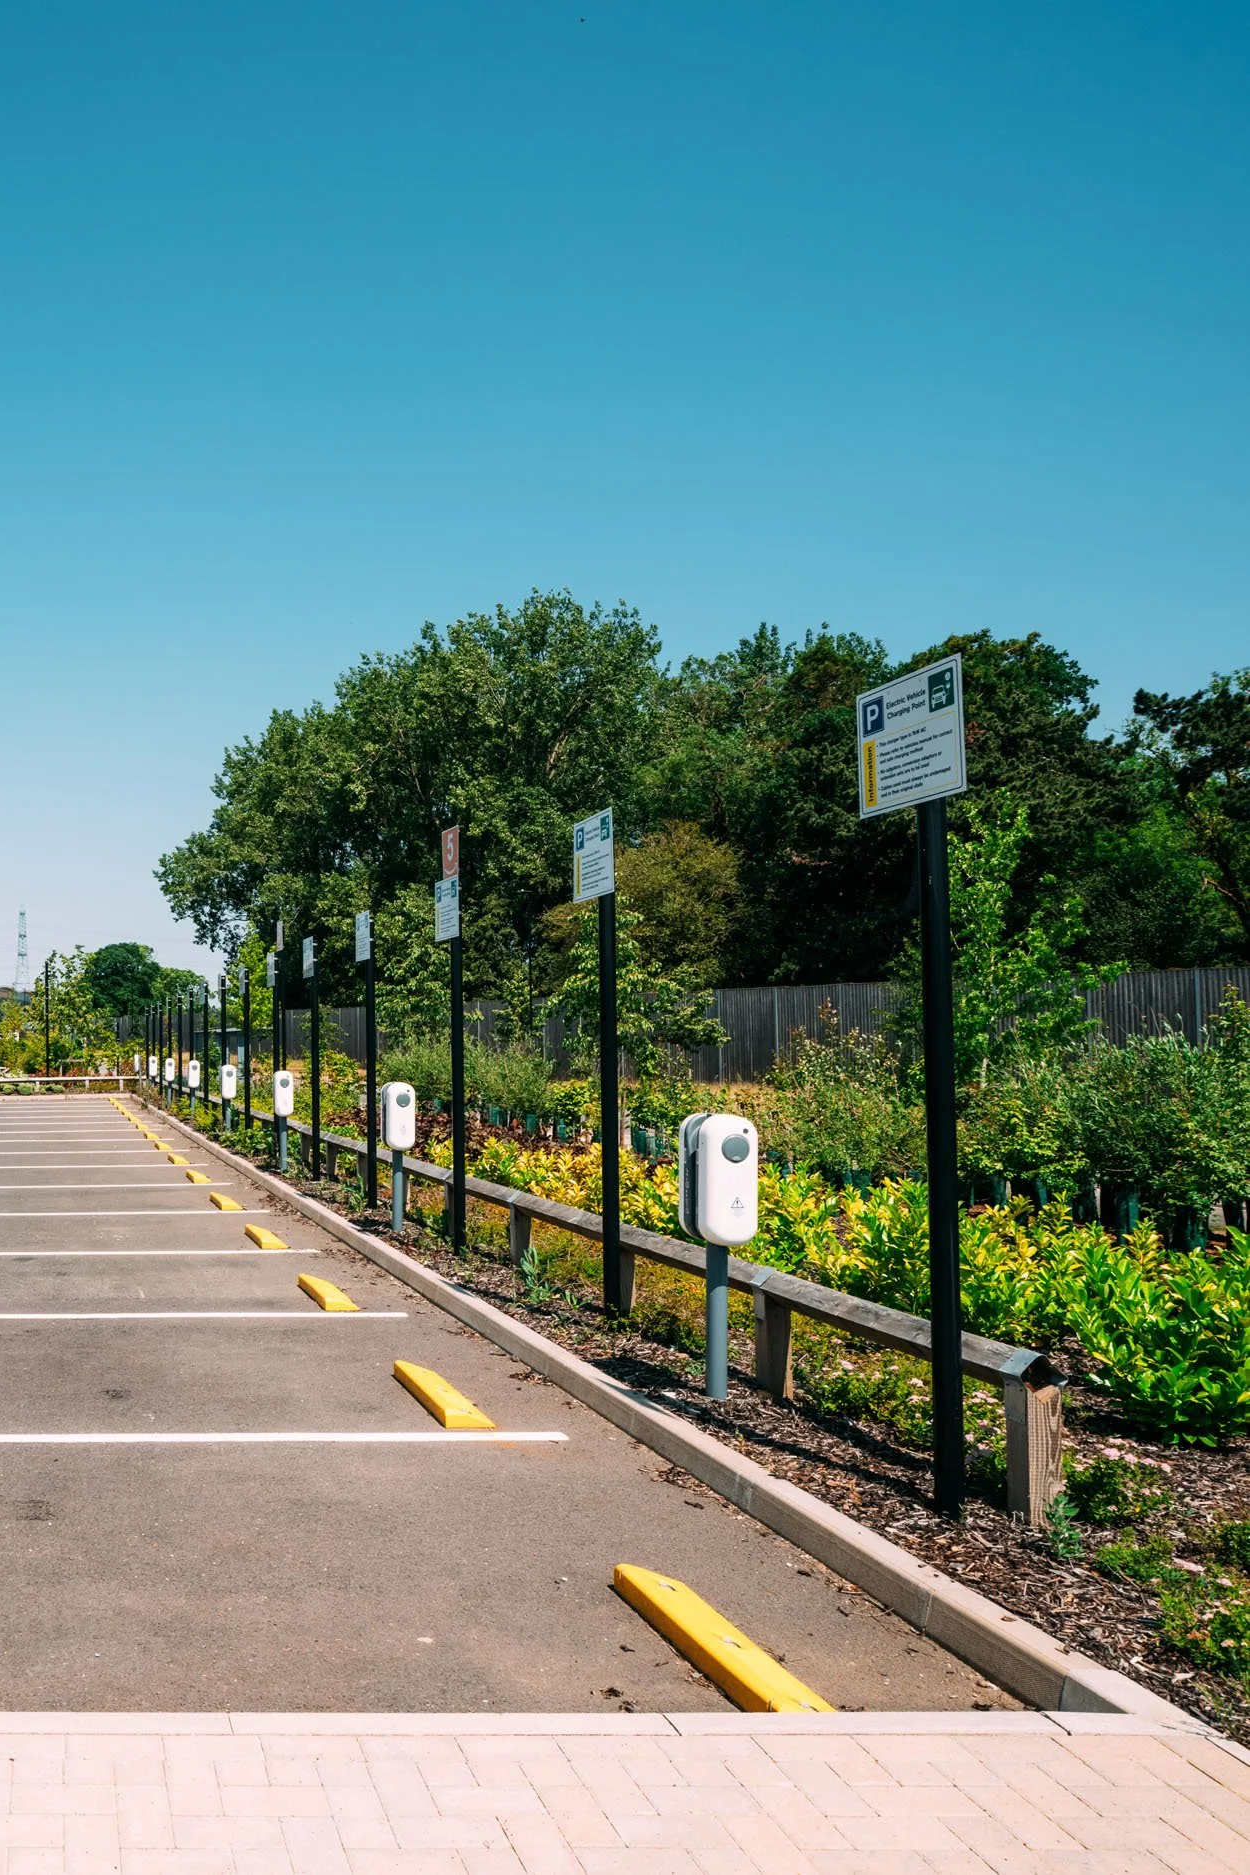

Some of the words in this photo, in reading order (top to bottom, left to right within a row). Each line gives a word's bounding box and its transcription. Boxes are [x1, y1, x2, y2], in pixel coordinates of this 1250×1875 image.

[886, 697, 905, 709] Electric
[907, 690, 925, 701] Vehicle
[867, 704, 879, 730] P
[887, 707, 910, 719] Charging
[912, 700, 926, 710] Point
[447, 833, 453, 861] 5
[577, 832, 583, 848] P
